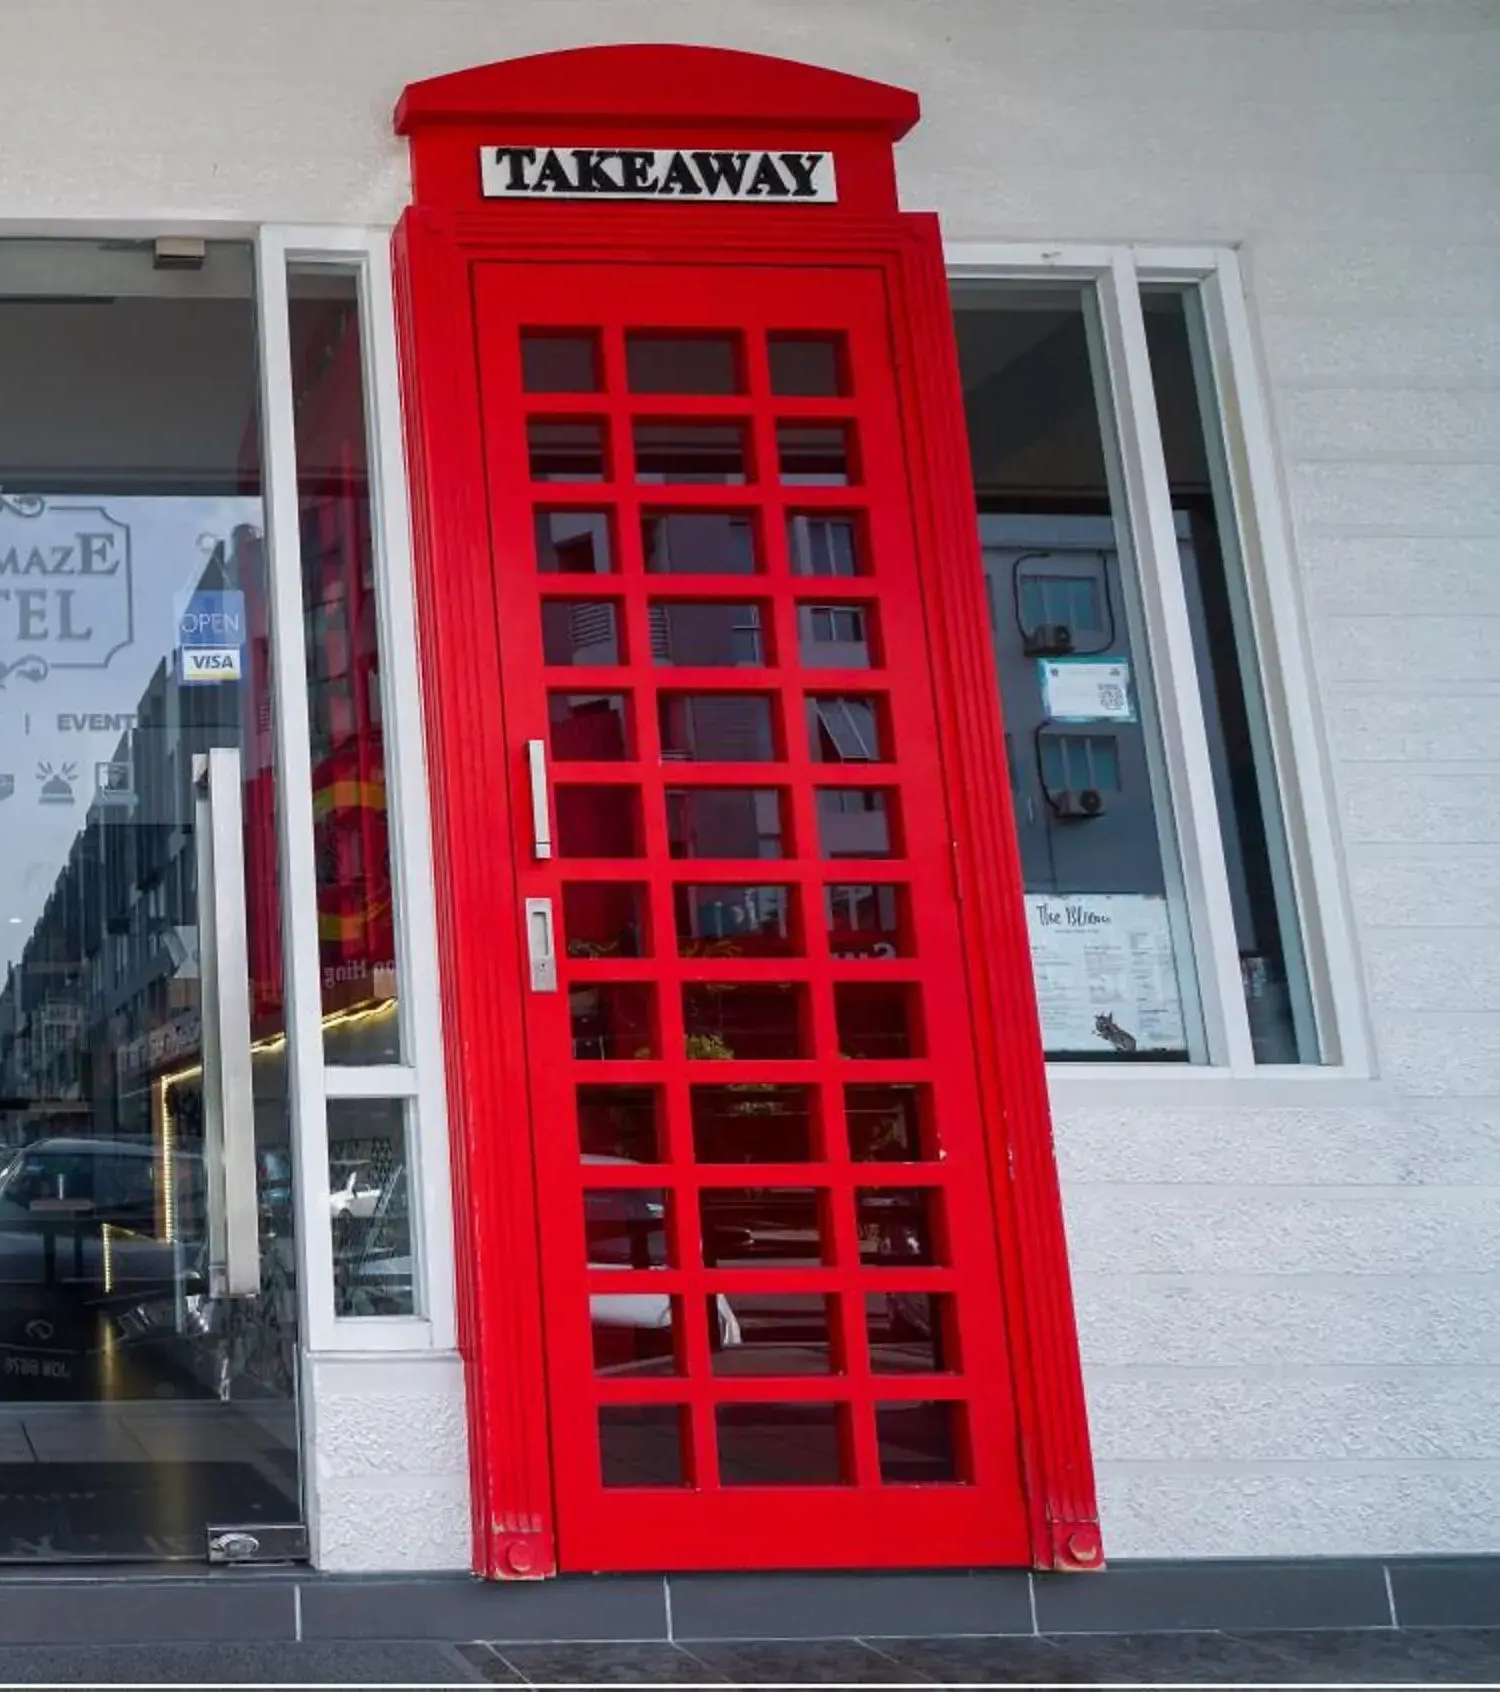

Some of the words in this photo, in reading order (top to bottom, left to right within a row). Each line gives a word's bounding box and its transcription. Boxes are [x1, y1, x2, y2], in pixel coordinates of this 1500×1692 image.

[496, 147, 823, 197] TAKEAWAY
[181, 613, 239, 633] OPEN
[191, 655, 234, 669] VISA
